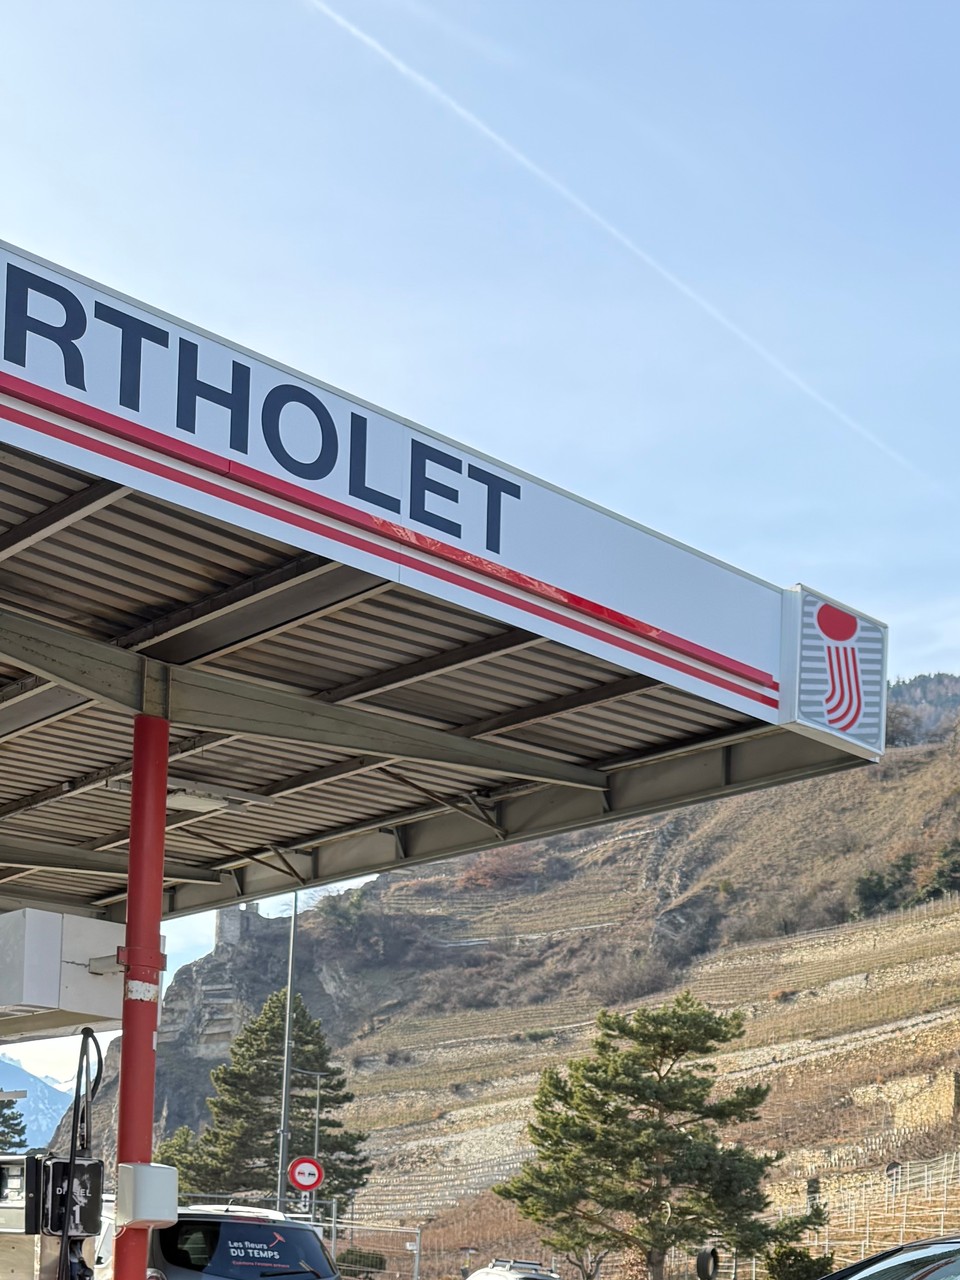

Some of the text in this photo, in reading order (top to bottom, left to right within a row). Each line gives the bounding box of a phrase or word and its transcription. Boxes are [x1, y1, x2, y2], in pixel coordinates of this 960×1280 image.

[3, 261, 522, 555] RTHOLET
[244, 1241, 268, 1250] fleurs
[230, 1248, 280, 1260] DU TEMPS
